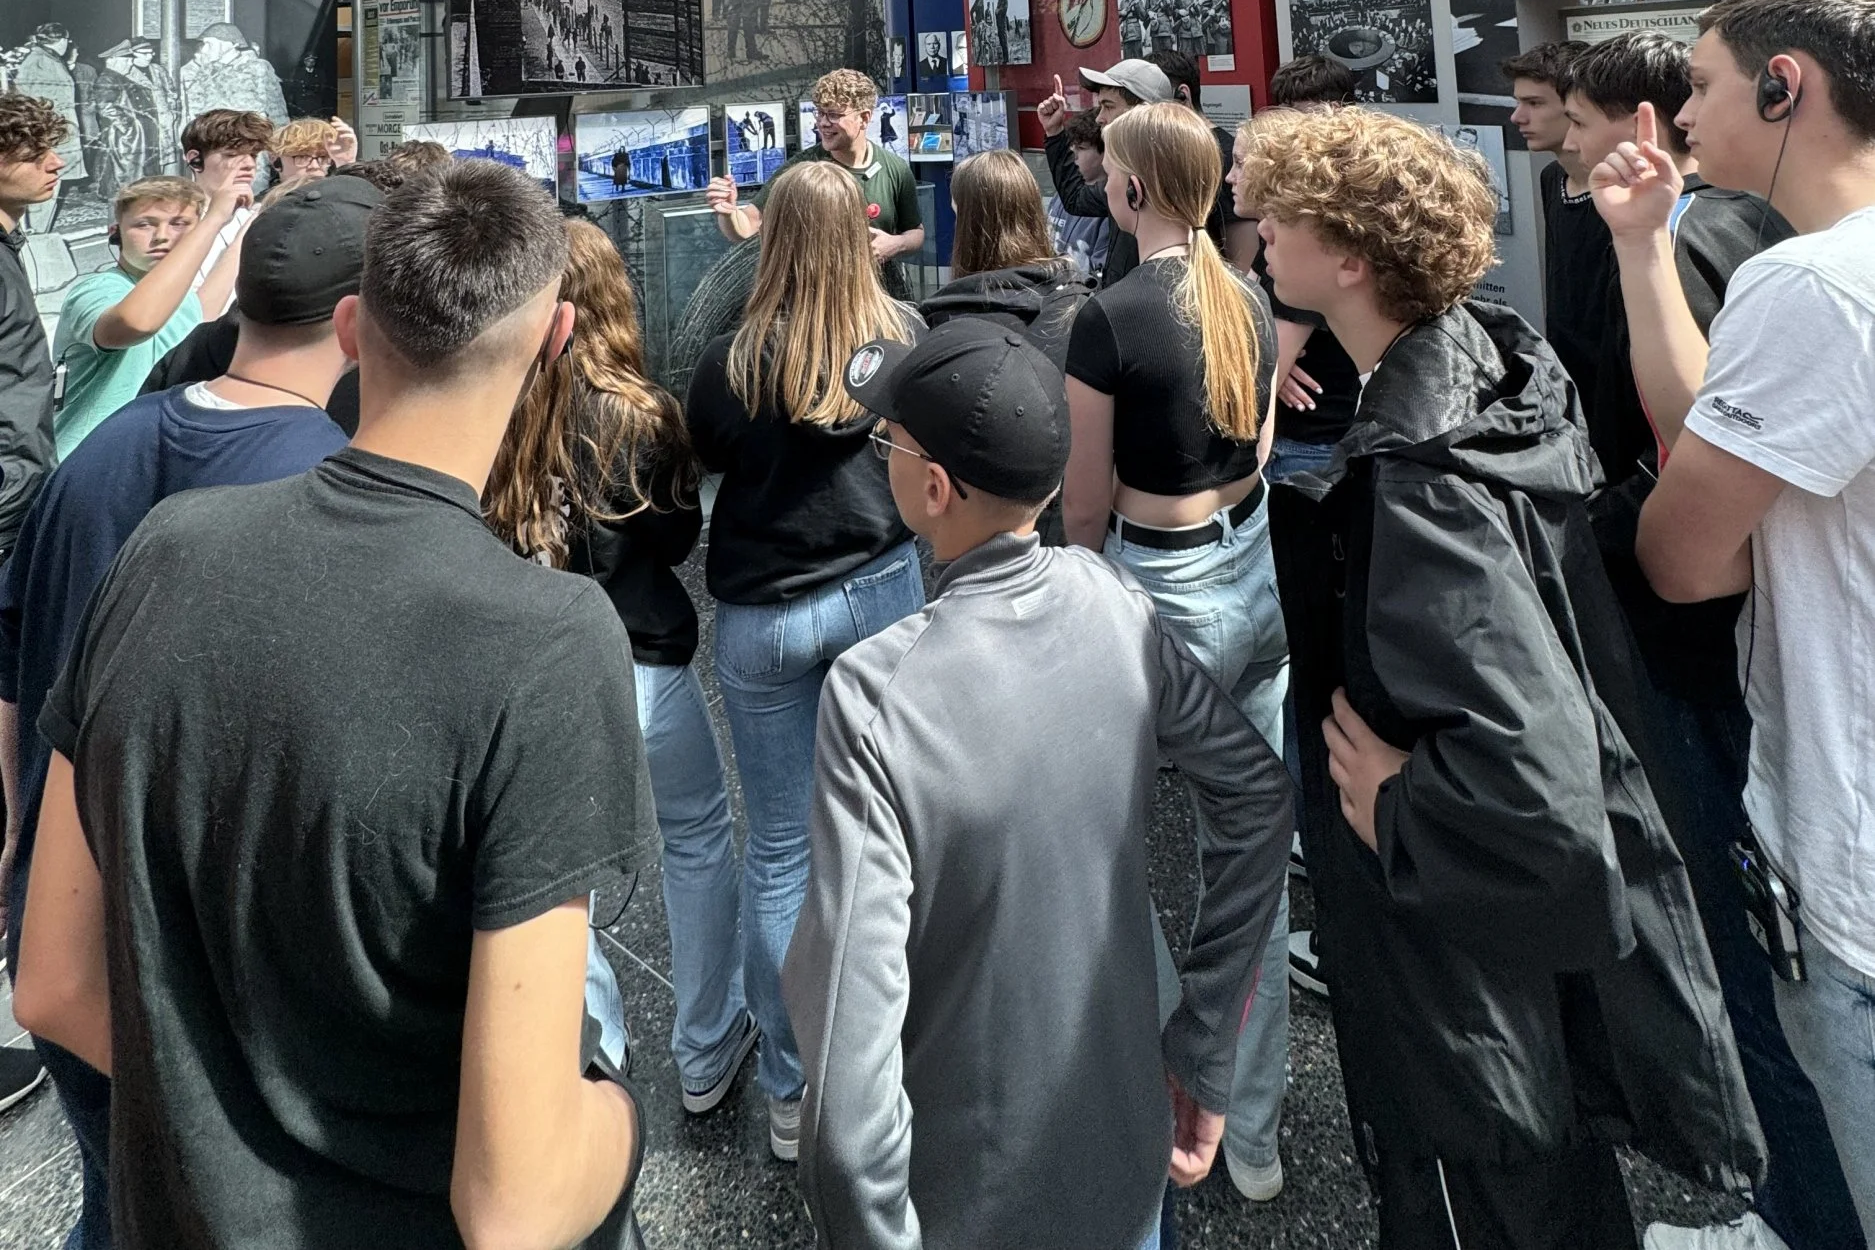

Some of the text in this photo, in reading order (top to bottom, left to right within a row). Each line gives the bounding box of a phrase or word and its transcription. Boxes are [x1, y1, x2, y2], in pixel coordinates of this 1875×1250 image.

[379, 2, 389, 13] vor
[1583, 15, 1697, 31] NEUES DEUTSCHLAN
[377, 123, 401, 134] MORGE
